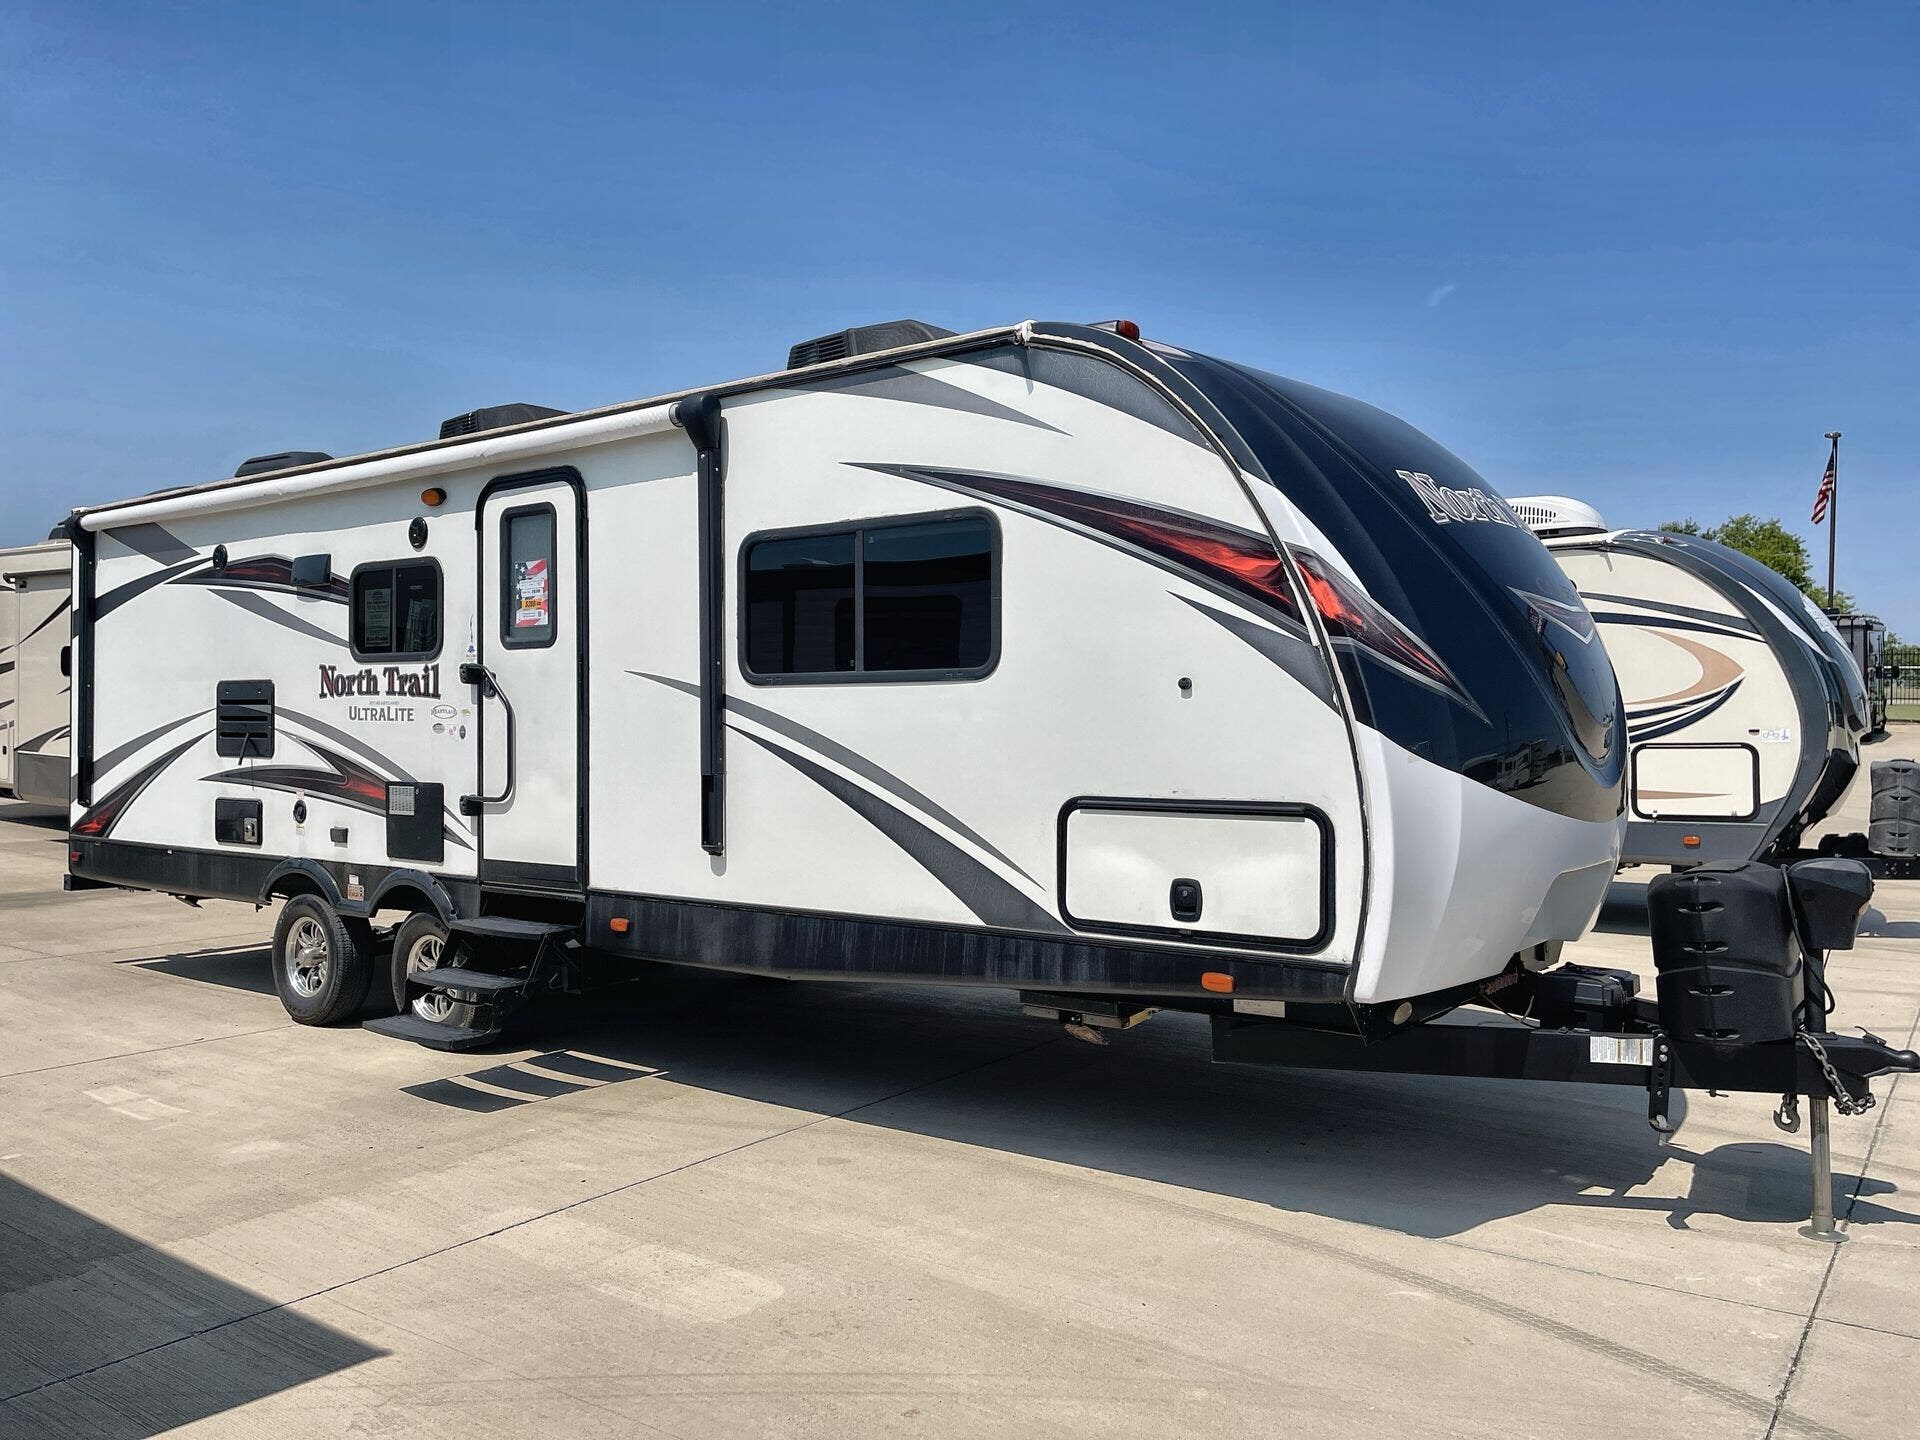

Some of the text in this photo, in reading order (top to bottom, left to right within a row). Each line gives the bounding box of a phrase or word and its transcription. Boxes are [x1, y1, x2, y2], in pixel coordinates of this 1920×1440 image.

[1395, 469, 1518, 528] North
[319, 663, 441, 700] North Trail
